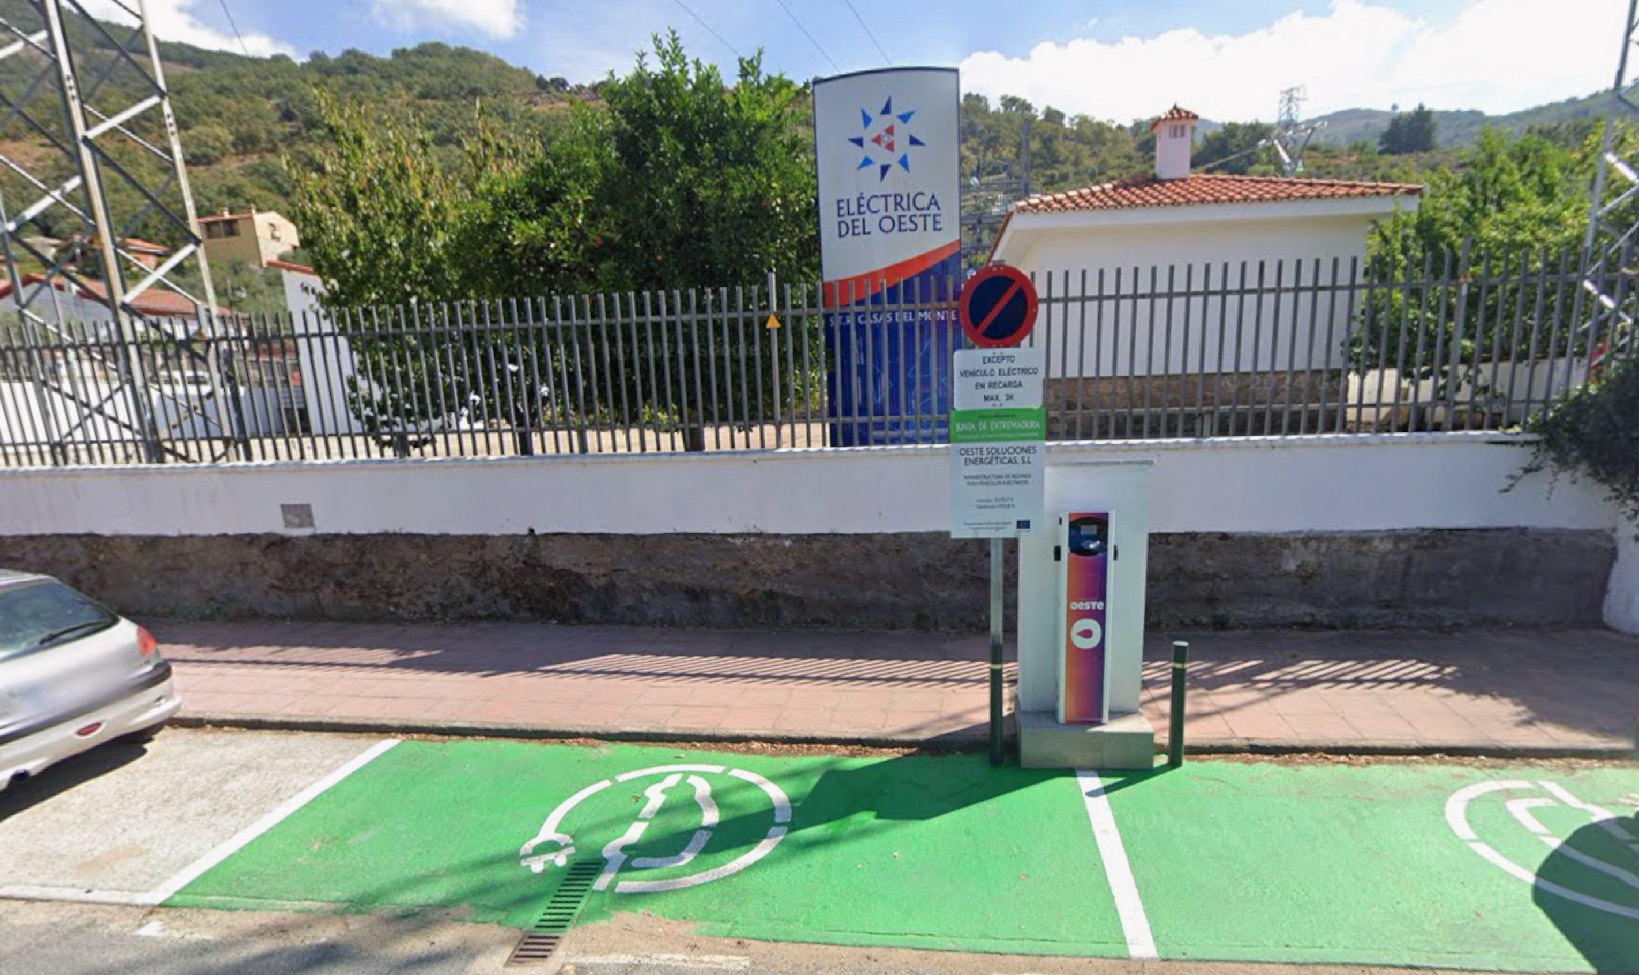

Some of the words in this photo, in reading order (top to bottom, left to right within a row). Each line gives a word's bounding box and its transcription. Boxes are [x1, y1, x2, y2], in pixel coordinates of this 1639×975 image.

[837, 191, 941, 218] ELÉCTRICA
[838, 218, 871, 239] DEL
[878, 214, 942, 234] OESTE
[857, 312, 893, 325] CSAS
[982, 355, 1016, 365] EXCEPTO
[959, 368, 995, 378] VEHÍCULO
[998, 366, 1039, 377] ELÉCTRICO
[975, 382, 986, 390] EN
[987, 380, 1023, 390] RECARGA
[955, 422, 976, 432] JUNTA
[978, 422, 986, 431] DE
[990, 420, 1040, 431] EXTREMADURA
[959, 447, 984, 457] OESTE
[985, 445, 1038, 457] SOLUCIONES
